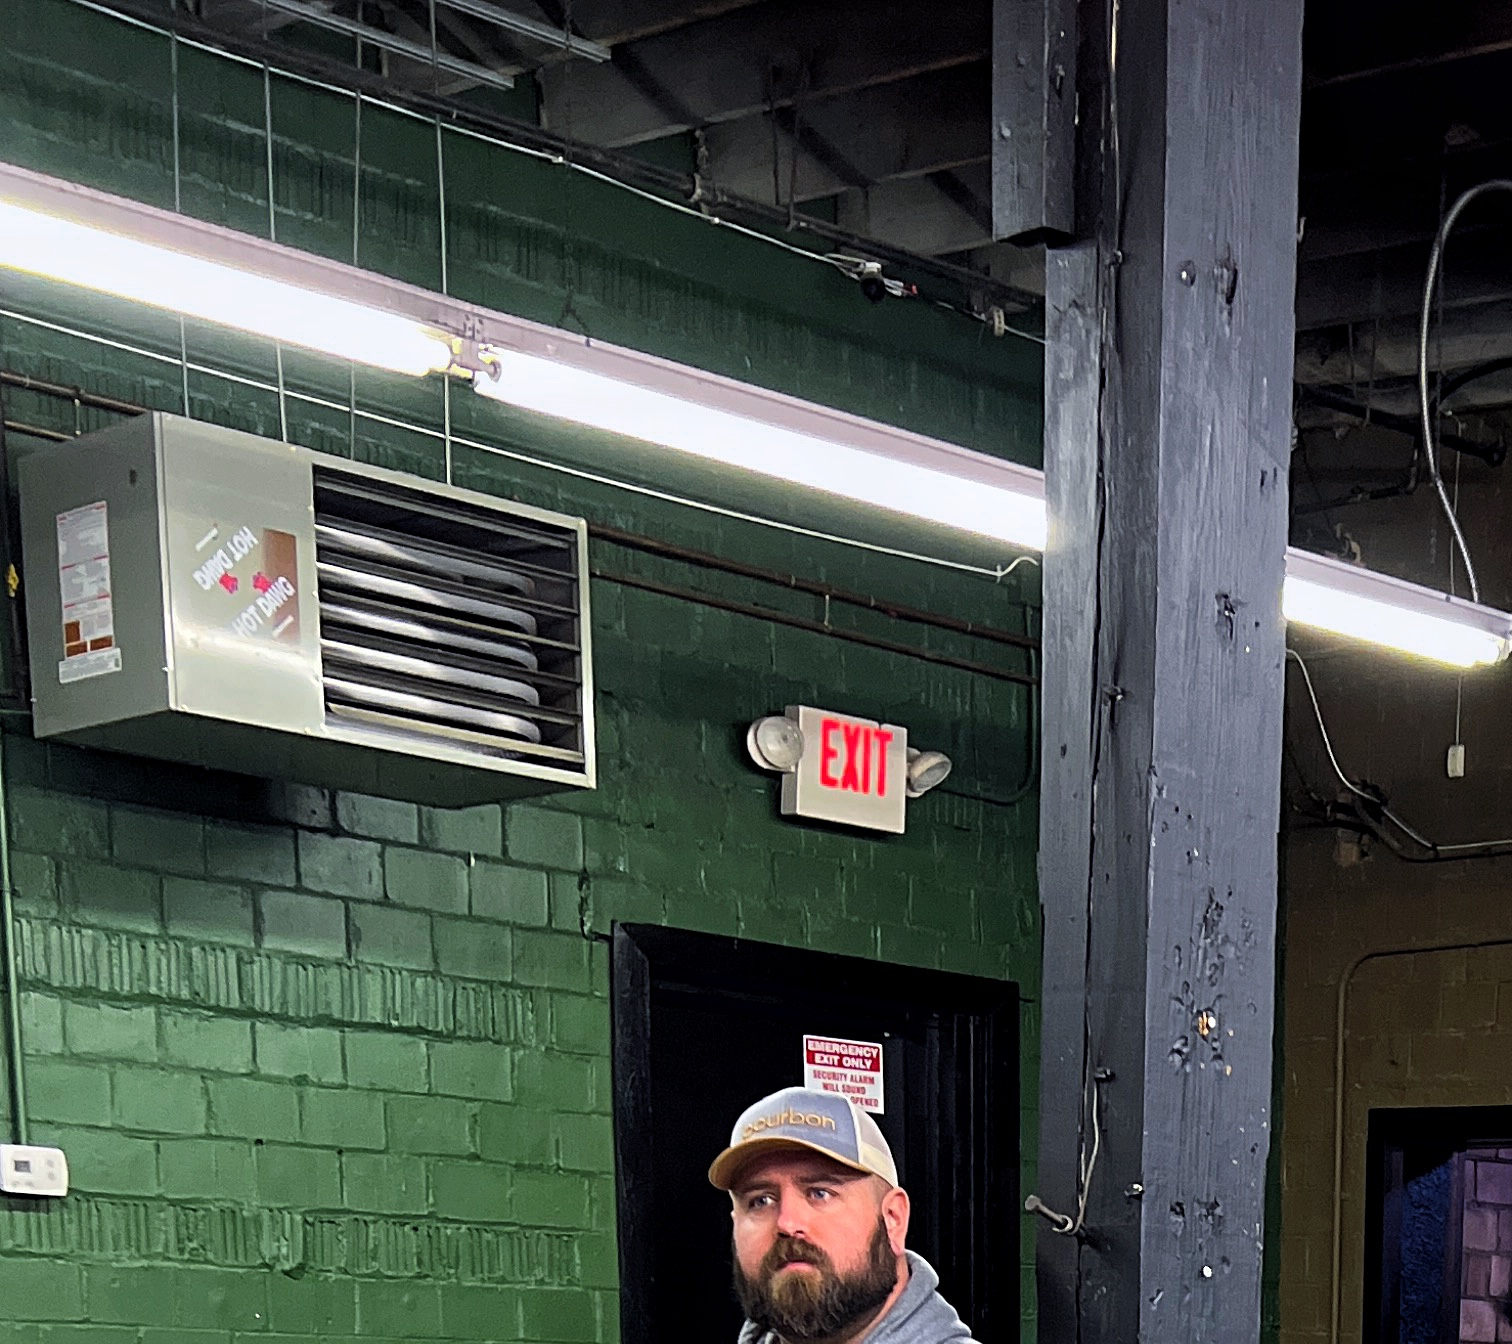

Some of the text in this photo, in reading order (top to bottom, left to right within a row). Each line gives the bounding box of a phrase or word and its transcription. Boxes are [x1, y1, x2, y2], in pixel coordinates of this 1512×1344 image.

[192, 525, 260, 591] HOT DAWG
[231, 576, 296, 639] HOT DAWG
[820, 717, 894, 798] EXIT
[807, 1039, 879, 1058] EMERGENCY
[814, 1053, 873, 1070] EXIT ONLY
[813, 1070, 875, 1085] SECURITY ALARM
[822, 1082, 866, 1095] WILL SOUND
[850, 1095, 879, 1108] OPENED
